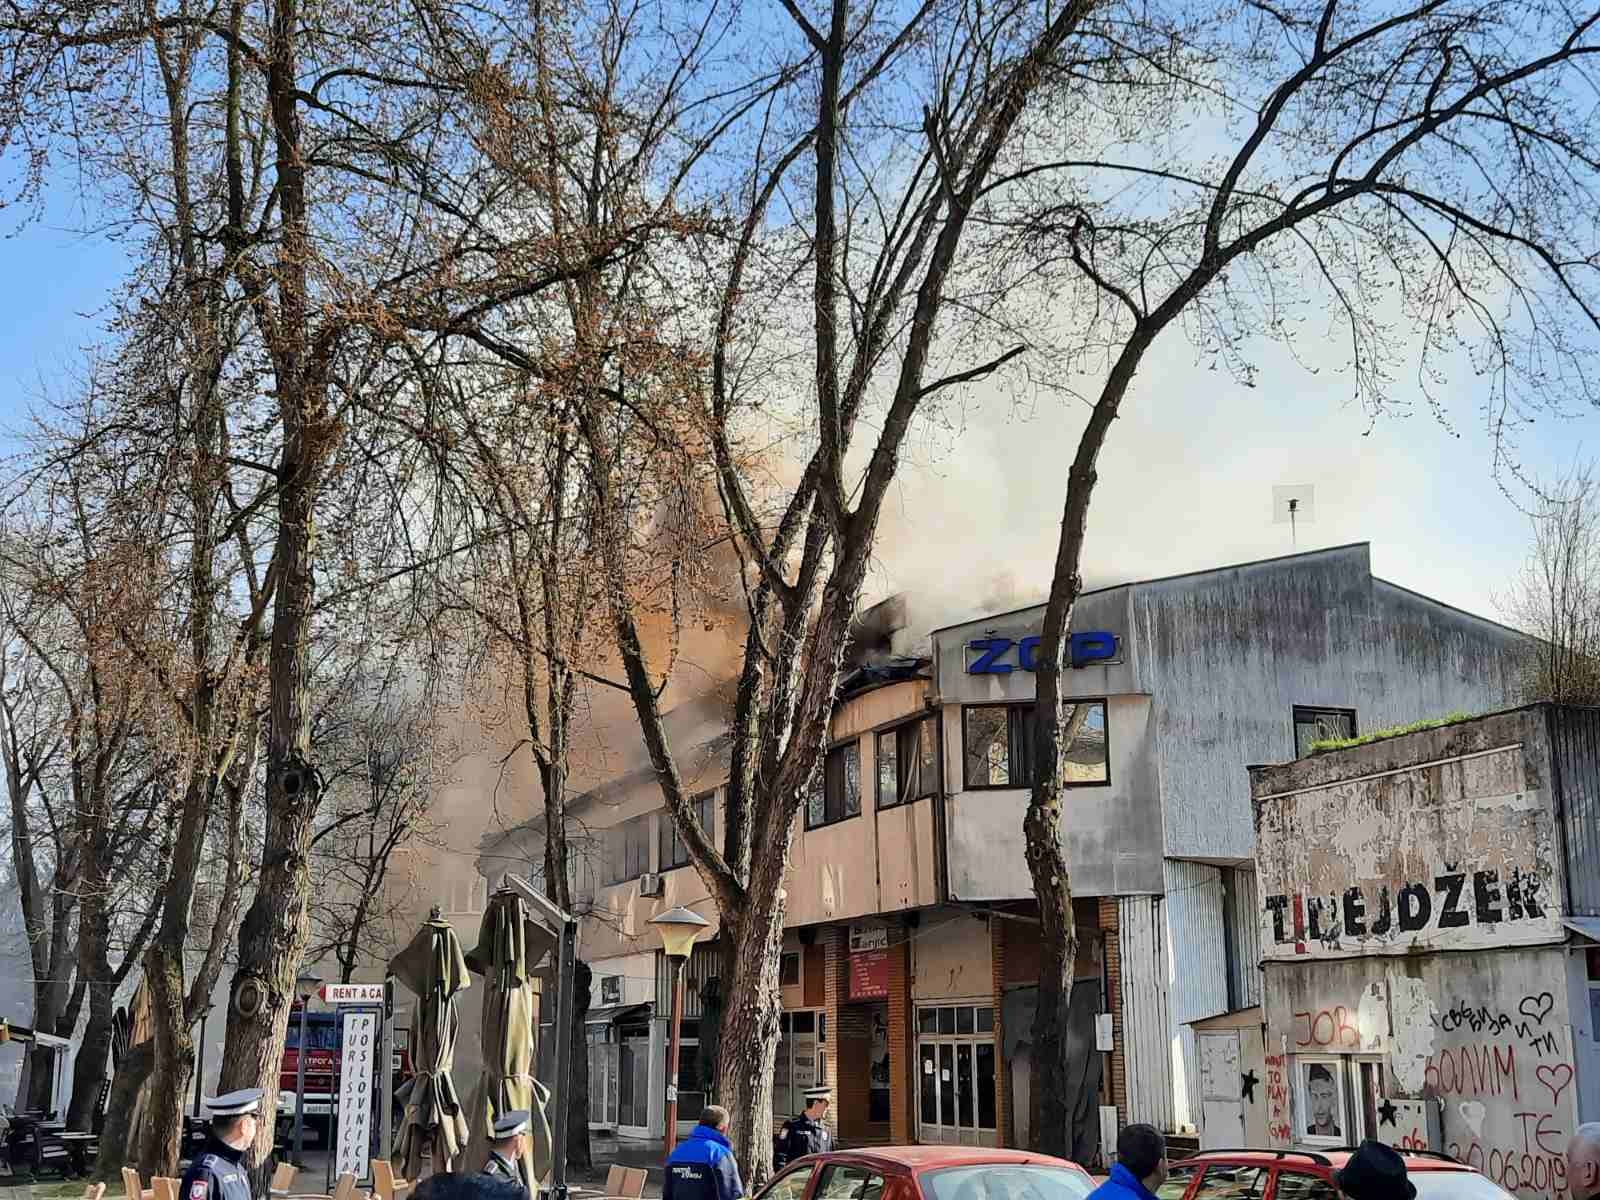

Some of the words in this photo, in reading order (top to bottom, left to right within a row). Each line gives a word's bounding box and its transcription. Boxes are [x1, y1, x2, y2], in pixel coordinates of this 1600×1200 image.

[333, 988, 358, 999] RENT
[361, 988, 367, 998] A
[369, 988, 384, 998] CA
[1267, 1071, 1281, 1084] TO
[353, 1018, 369, 1174] POSLOVNICA
